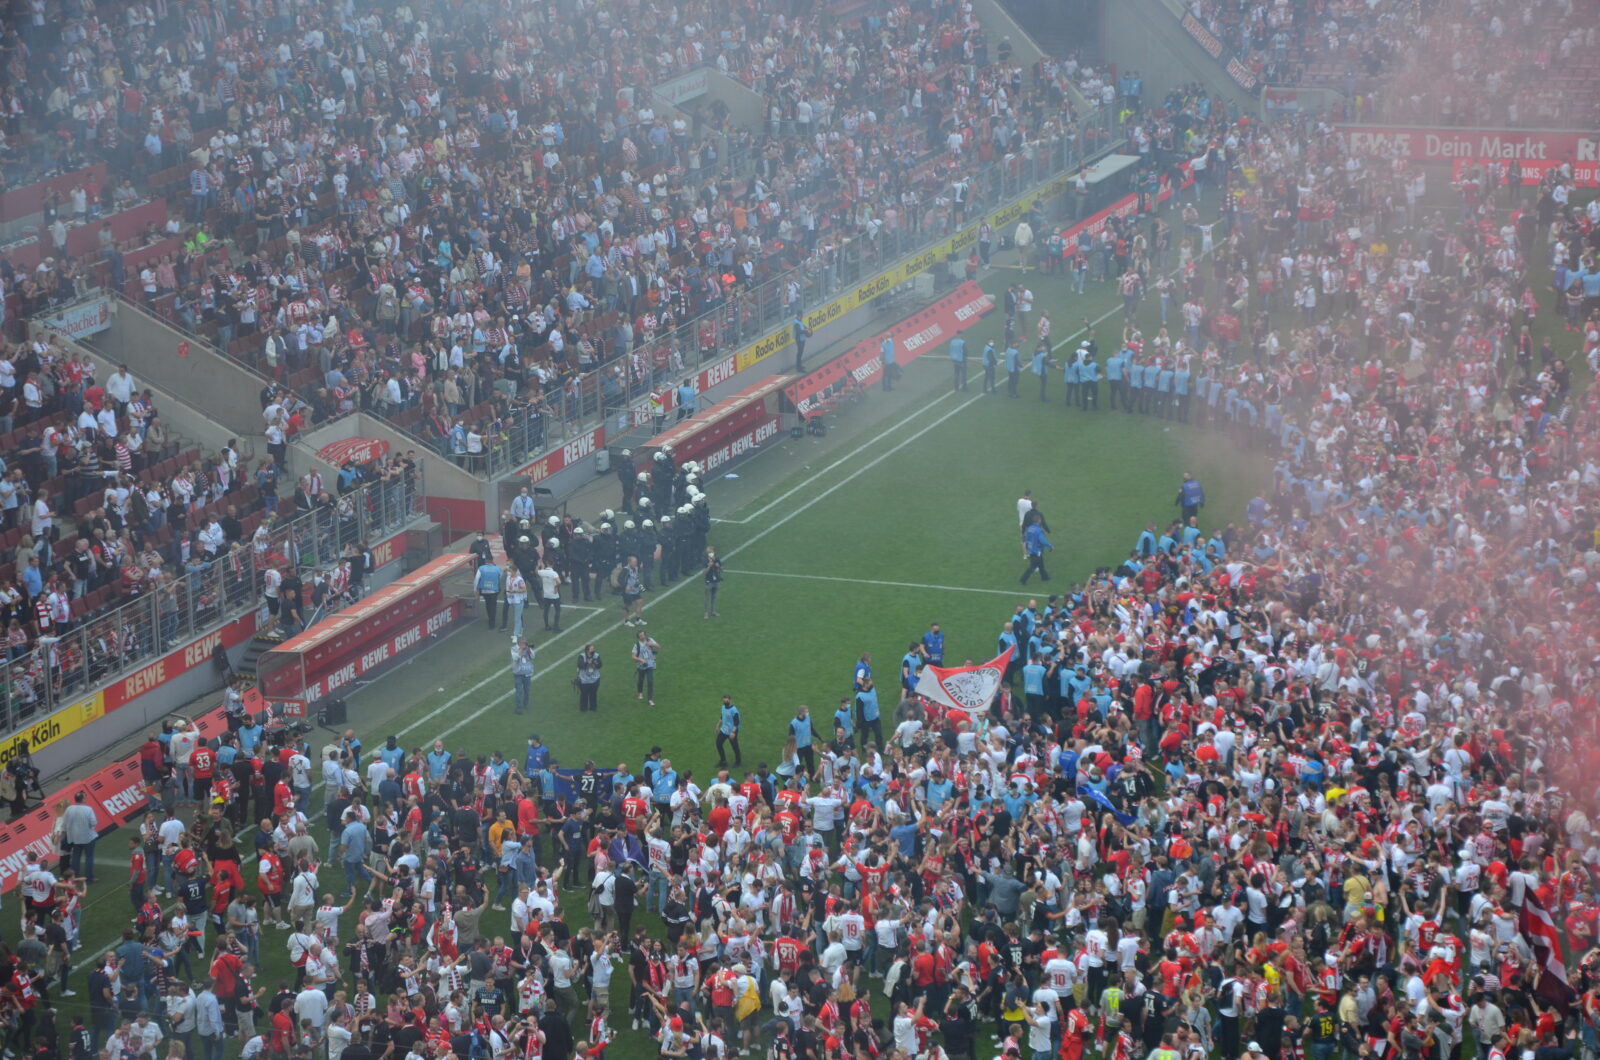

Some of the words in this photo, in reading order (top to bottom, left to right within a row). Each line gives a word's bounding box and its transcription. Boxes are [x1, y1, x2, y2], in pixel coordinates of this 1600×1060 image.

[1425, 134, 1472, 157] Dein
[1479, 136, 1547, 160] Markt
[808, 308, 826, 329] Radio
[827, 302, 841, 319] Köln
[755, 337, 775, 359] Radio
[775, 328, 791, 349] Köln
[707, 356, 735, 388] REWE
[564, 431, 596, 466] REWE
[706, 447, 730, 472] REWE
[731, 432, 754, 458] REWE
[756, 419, 778, 442] REWE
[327, 662, 356, 691] REWE
[362, 643, 390, 672] REWE
[394, 624, 421, 653] REWE
[426, 606, 453, 635] REWE
[125, 661, 166, 700] REWE
[31, 719, 61, 748] Köln
[196, 755, 210, 768] 33
[581, 778, 595, 791] 27
[103, 784, 146, 816] REWE
[625, 804, 637, 818] 27
[736, 803, 744, 815] 6
[0, 848, 28, 882] EWE
[189, 886, 200, 898] 27
[846, 923, 857, 937] 19
[1011, 951, 1022, 965] 18
[1054, 973, 1066, 987] 10
[1320, 1022, 1333, 1036] 19
